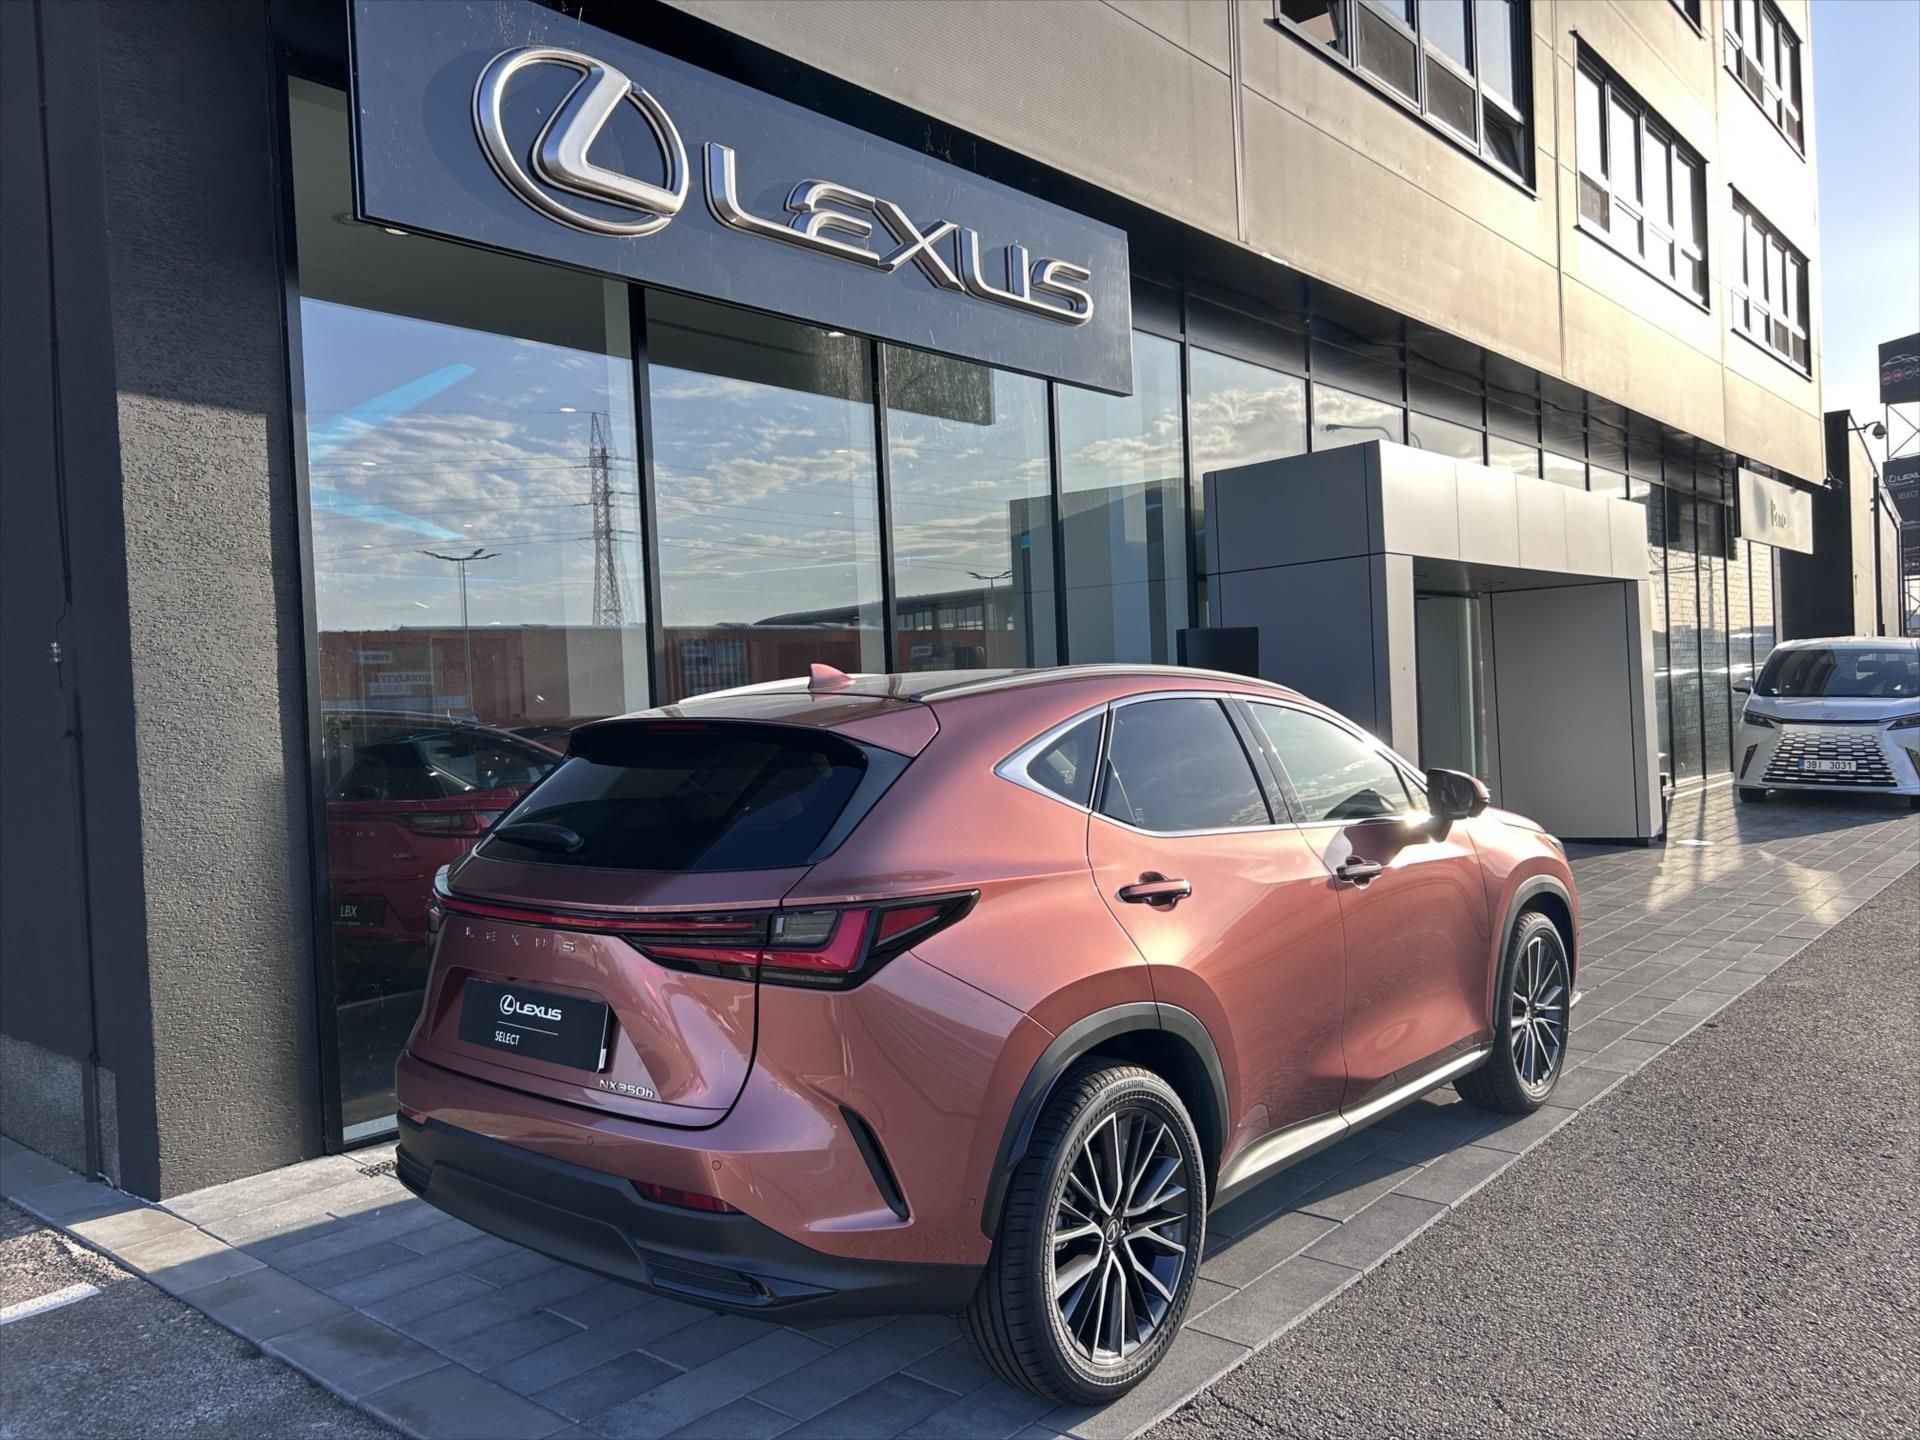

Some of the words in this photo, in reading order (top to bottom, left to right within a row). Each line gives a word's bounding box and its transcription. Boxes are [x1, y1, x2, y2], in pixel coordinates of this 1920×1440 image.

[704, 141, 1094, 326] LEXUS
[1829, 761, 1852, 770] 3031
[340, 904, 358, 917] LBX
[465, 926, 577, 953] LEXUS
[516, 1001, 562, 1021] LEXUS
[494, 1030, 520, 1046] SELECT
